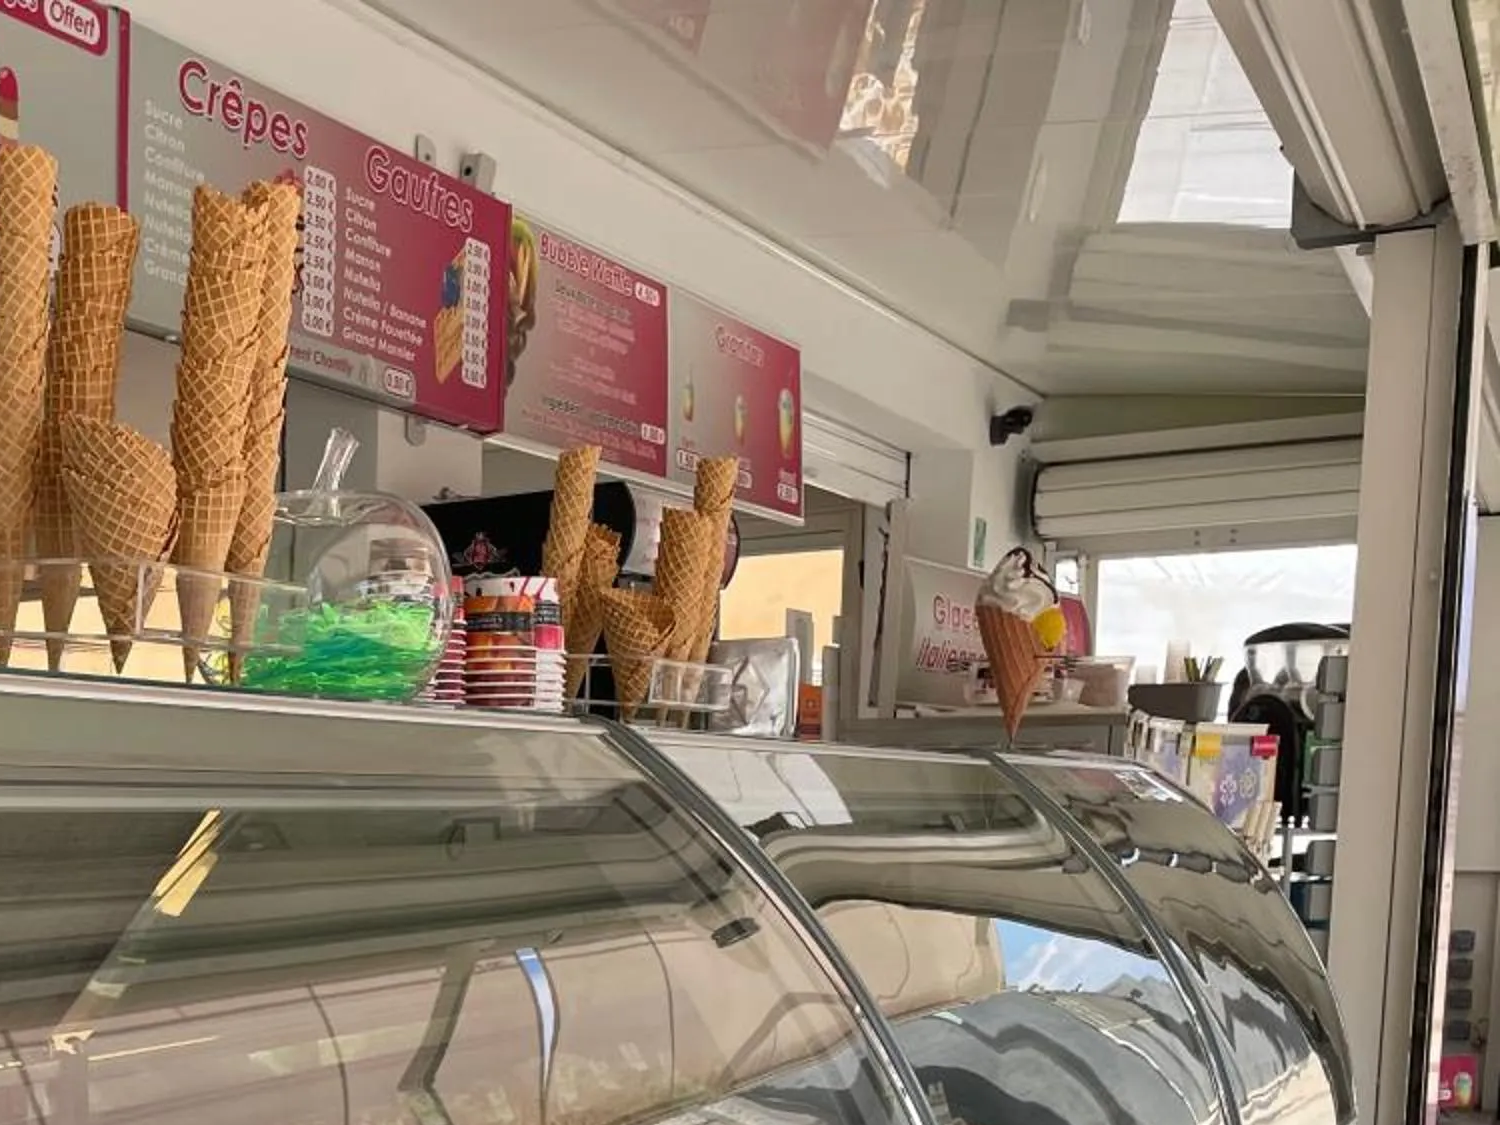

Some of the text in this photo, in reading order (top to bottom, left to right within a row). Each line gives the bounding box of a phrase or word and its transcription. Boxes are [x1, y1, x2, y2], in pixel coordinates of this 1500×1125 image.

[49, 0, 96, 38] Offert
[178, 60, 308, 158] Crêpes
[364, 145, 474, 233] Gaufres
[932, 593, 979, 630] Glac
